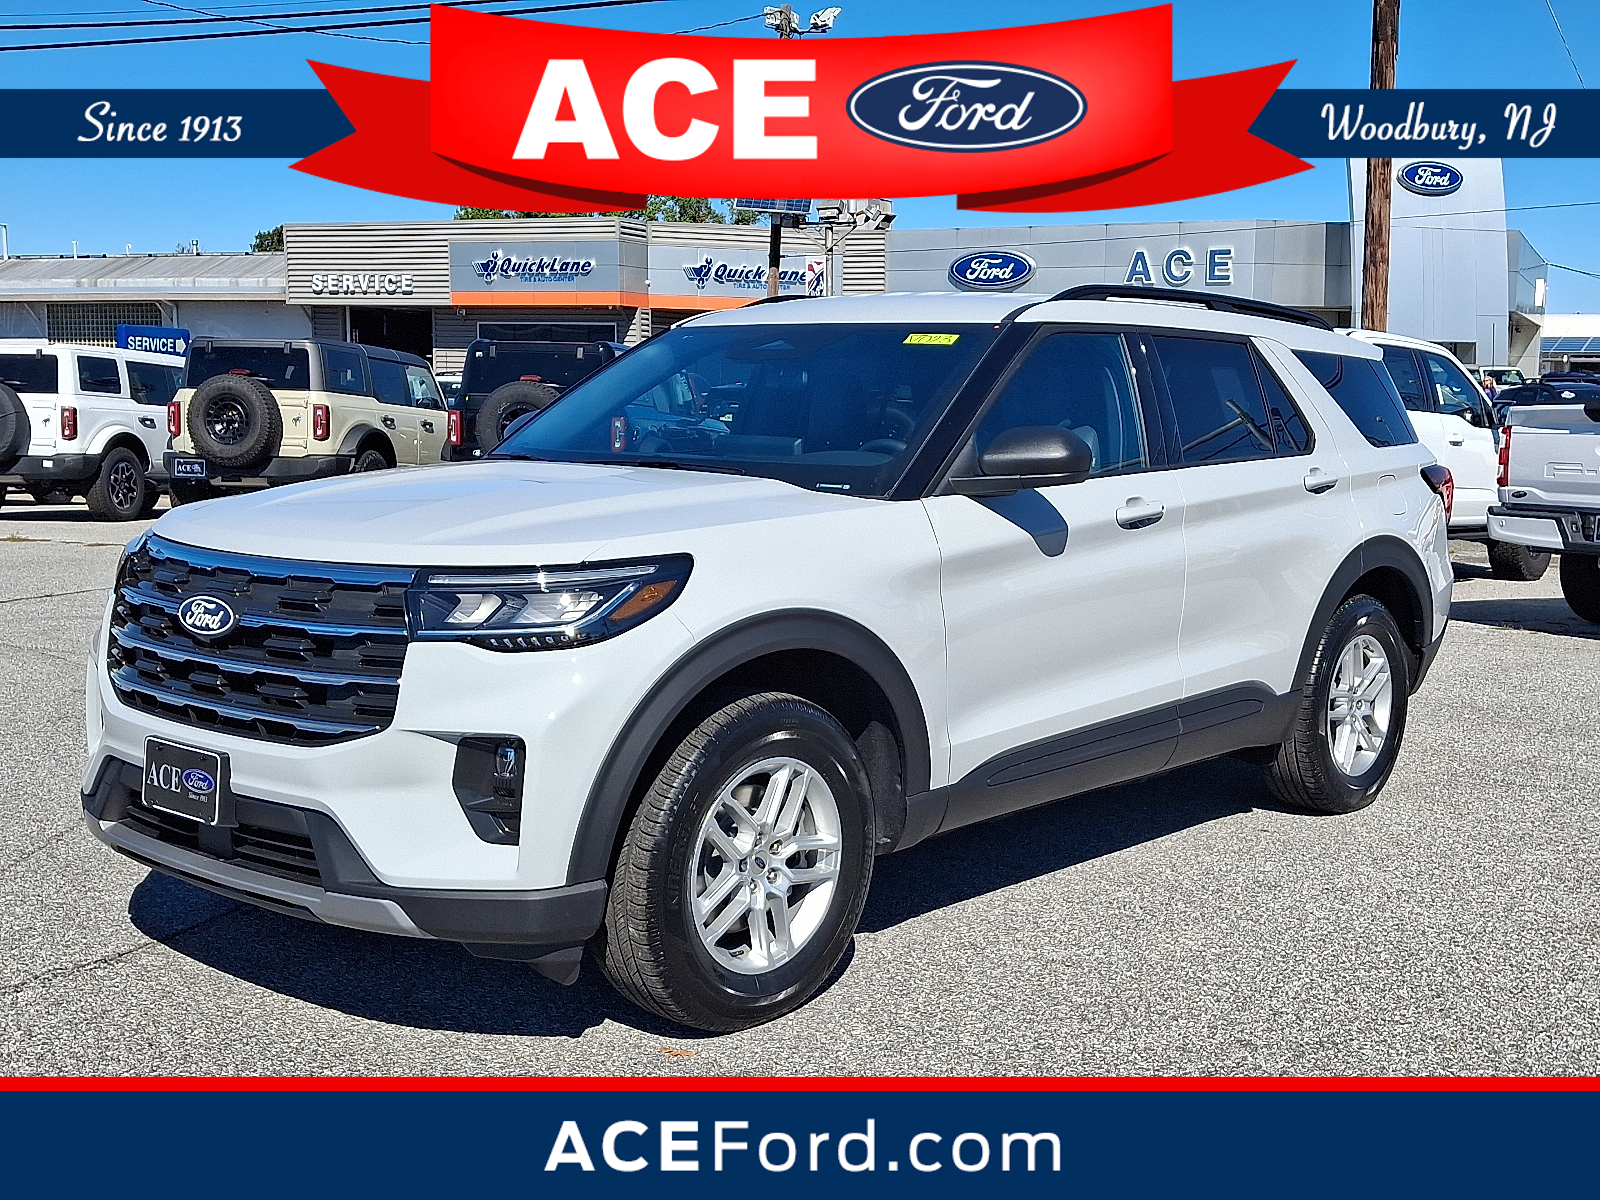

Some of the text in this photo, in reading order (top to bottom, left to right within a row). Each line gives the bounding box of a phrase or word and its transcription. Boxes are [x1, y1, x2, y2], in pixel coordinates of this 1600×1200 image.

[1123, 246, 1234, 286] ACE
[311, 274, 414, 293] SERVICE
[127, 336, 174, 352] SERVICE
[1544, 462, 1600, 478] F-
[186, 600, 224, 630] Ford
[147, 761, 182, 793] ACE
